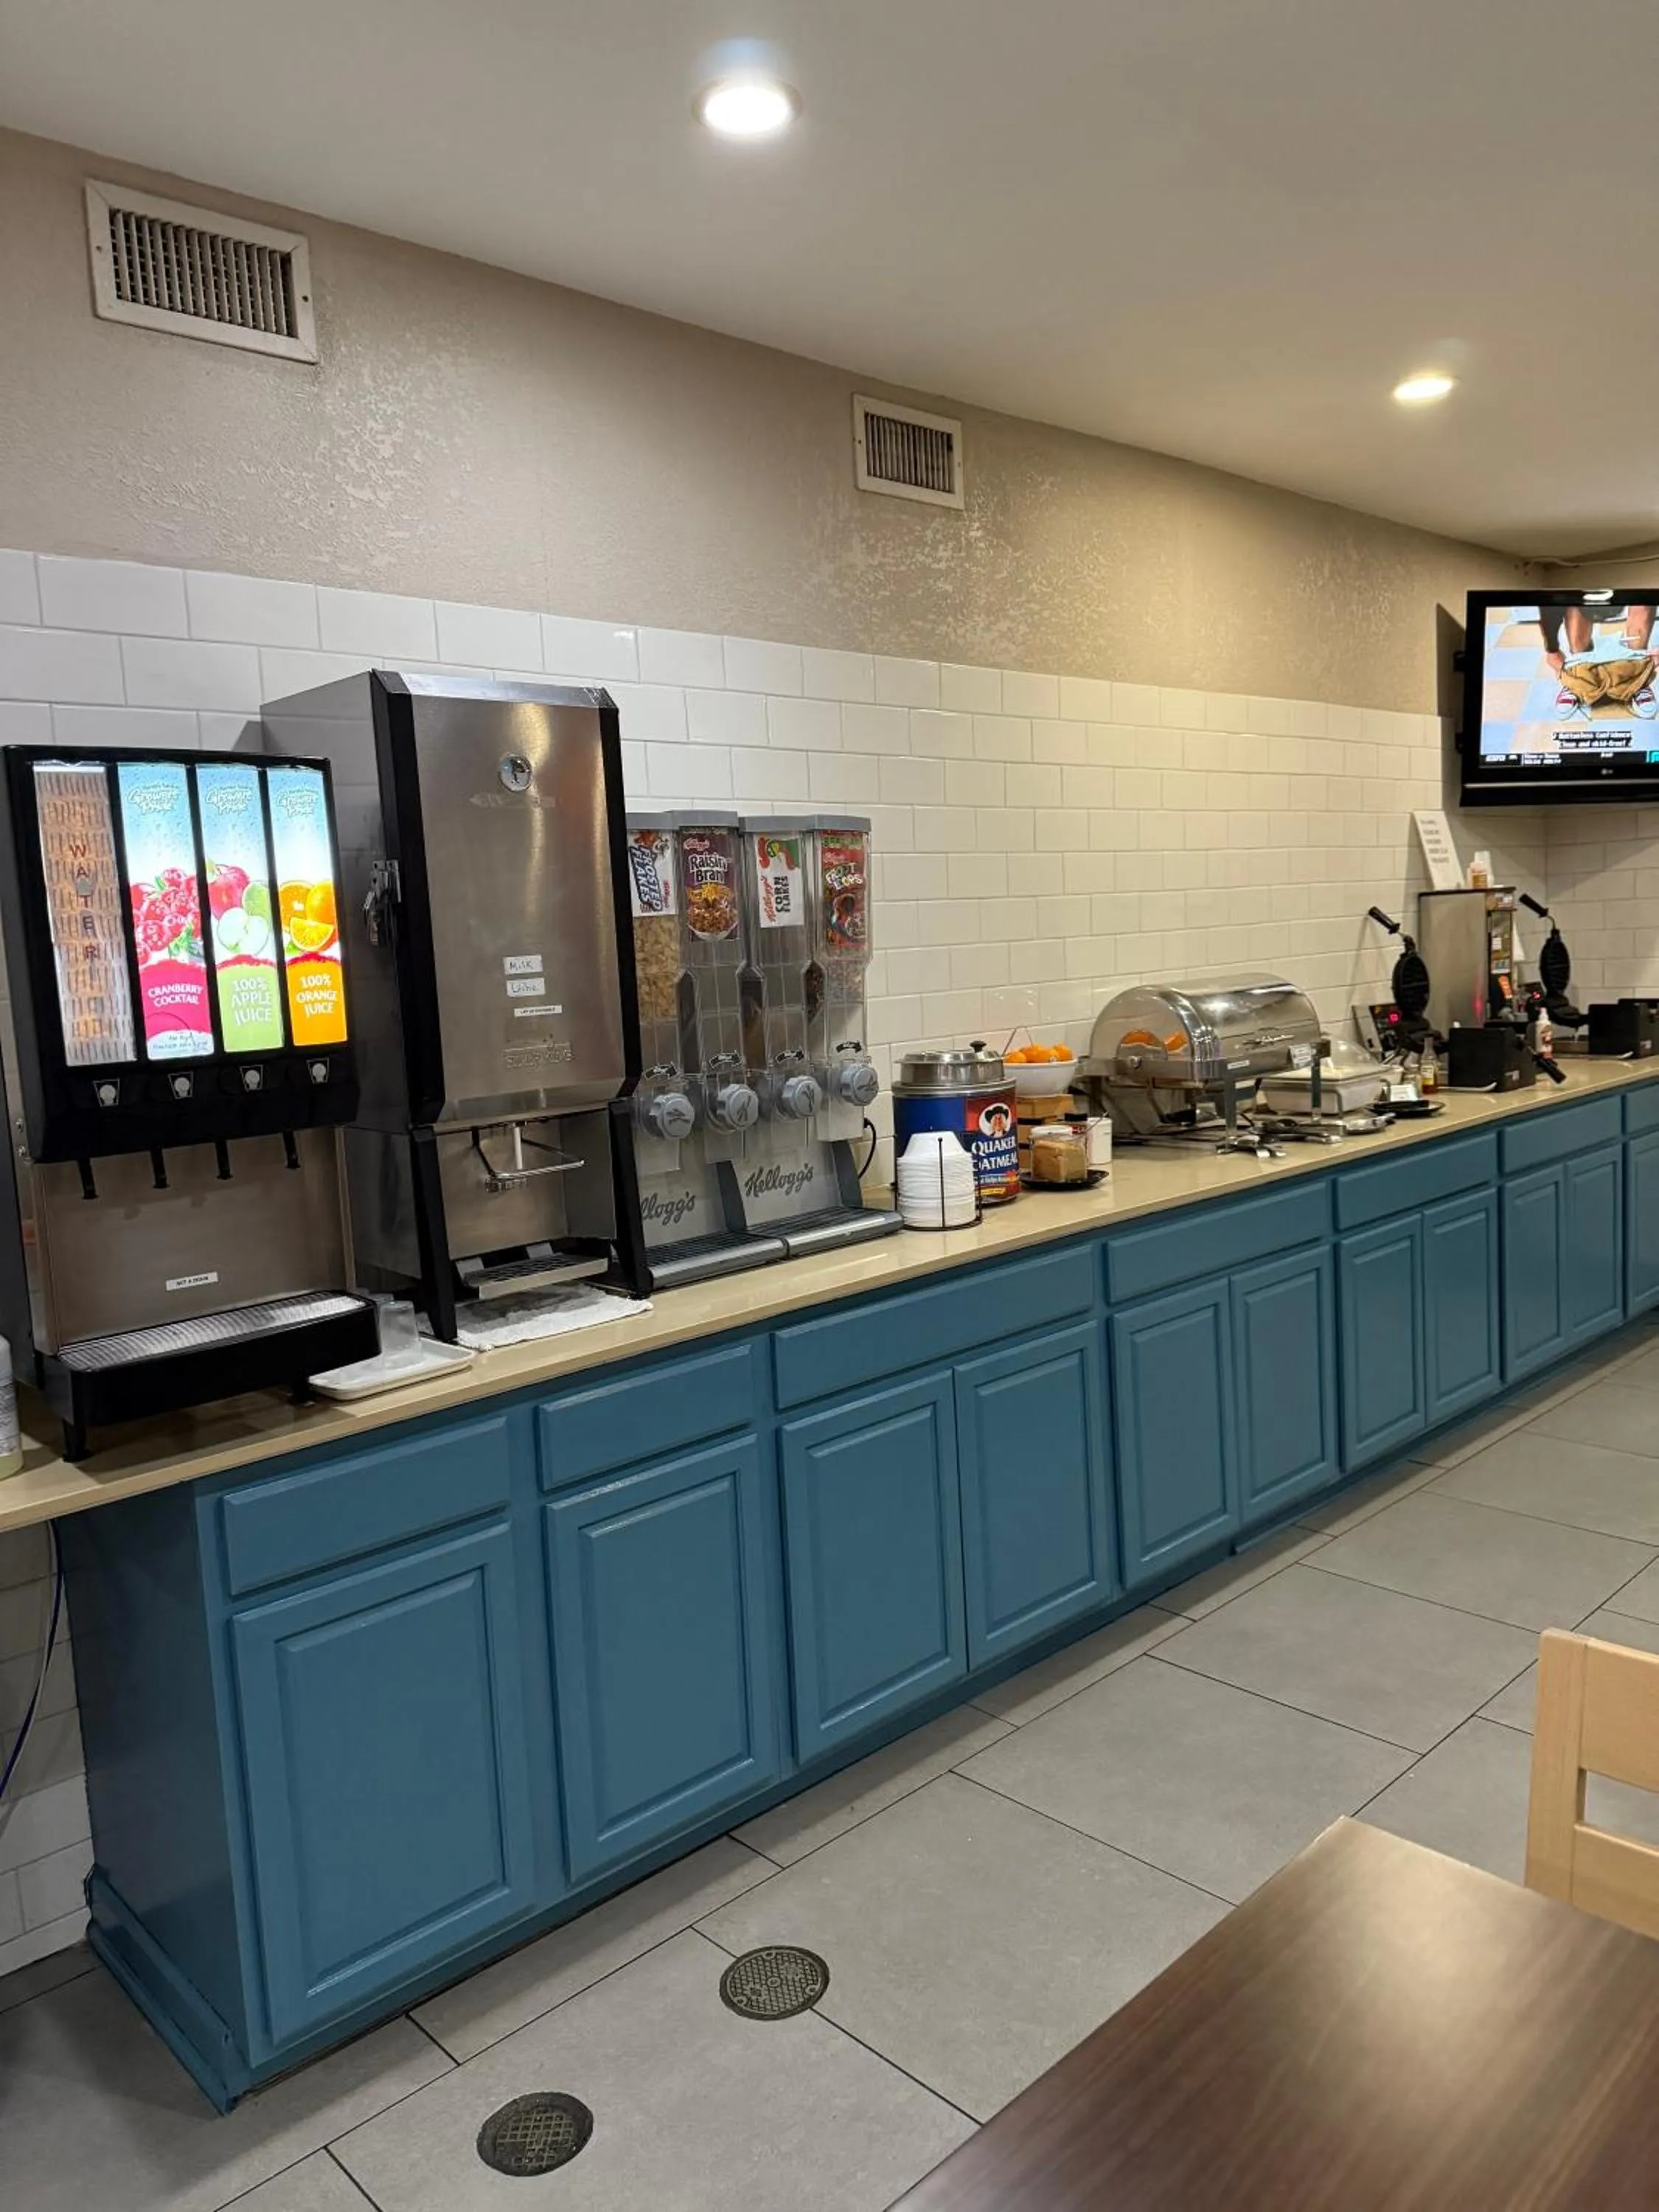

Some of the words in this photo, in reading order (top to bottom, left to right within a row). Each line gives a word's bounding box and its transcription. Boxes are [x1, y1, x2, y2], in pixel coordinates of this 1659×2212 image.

[689, 852, 728, 872] Raisin
[630, 846, 650, 902] FLAKES
[639, 845, 662, 911] FROSTED
[695, 869, 725, 885] Bran
[70, 844, 98, 959] WATER
[774, 876, 783, 912] CORN
[782, 875, 791, 912] FLAKES
[147, 983, 203, 998] CRANBERRY
[232, 976, 268, 992] 100%
[299, 973, 332, 989] 100%
[153, 994, 200, 1007] COCKTAIL
[232, 992, 272, 1008] APPLE
[296, 990, 338, 1004] ORANGE
[234, 1007, 272, 1026] JUICE
[305, 1002, 334, 1018] JUICE
[971, 1136, 1016, 1157] QUAKER
[744, 1162, 814, 1198] Kellogg's
[640, 1191, 696, 1226] llogg's
